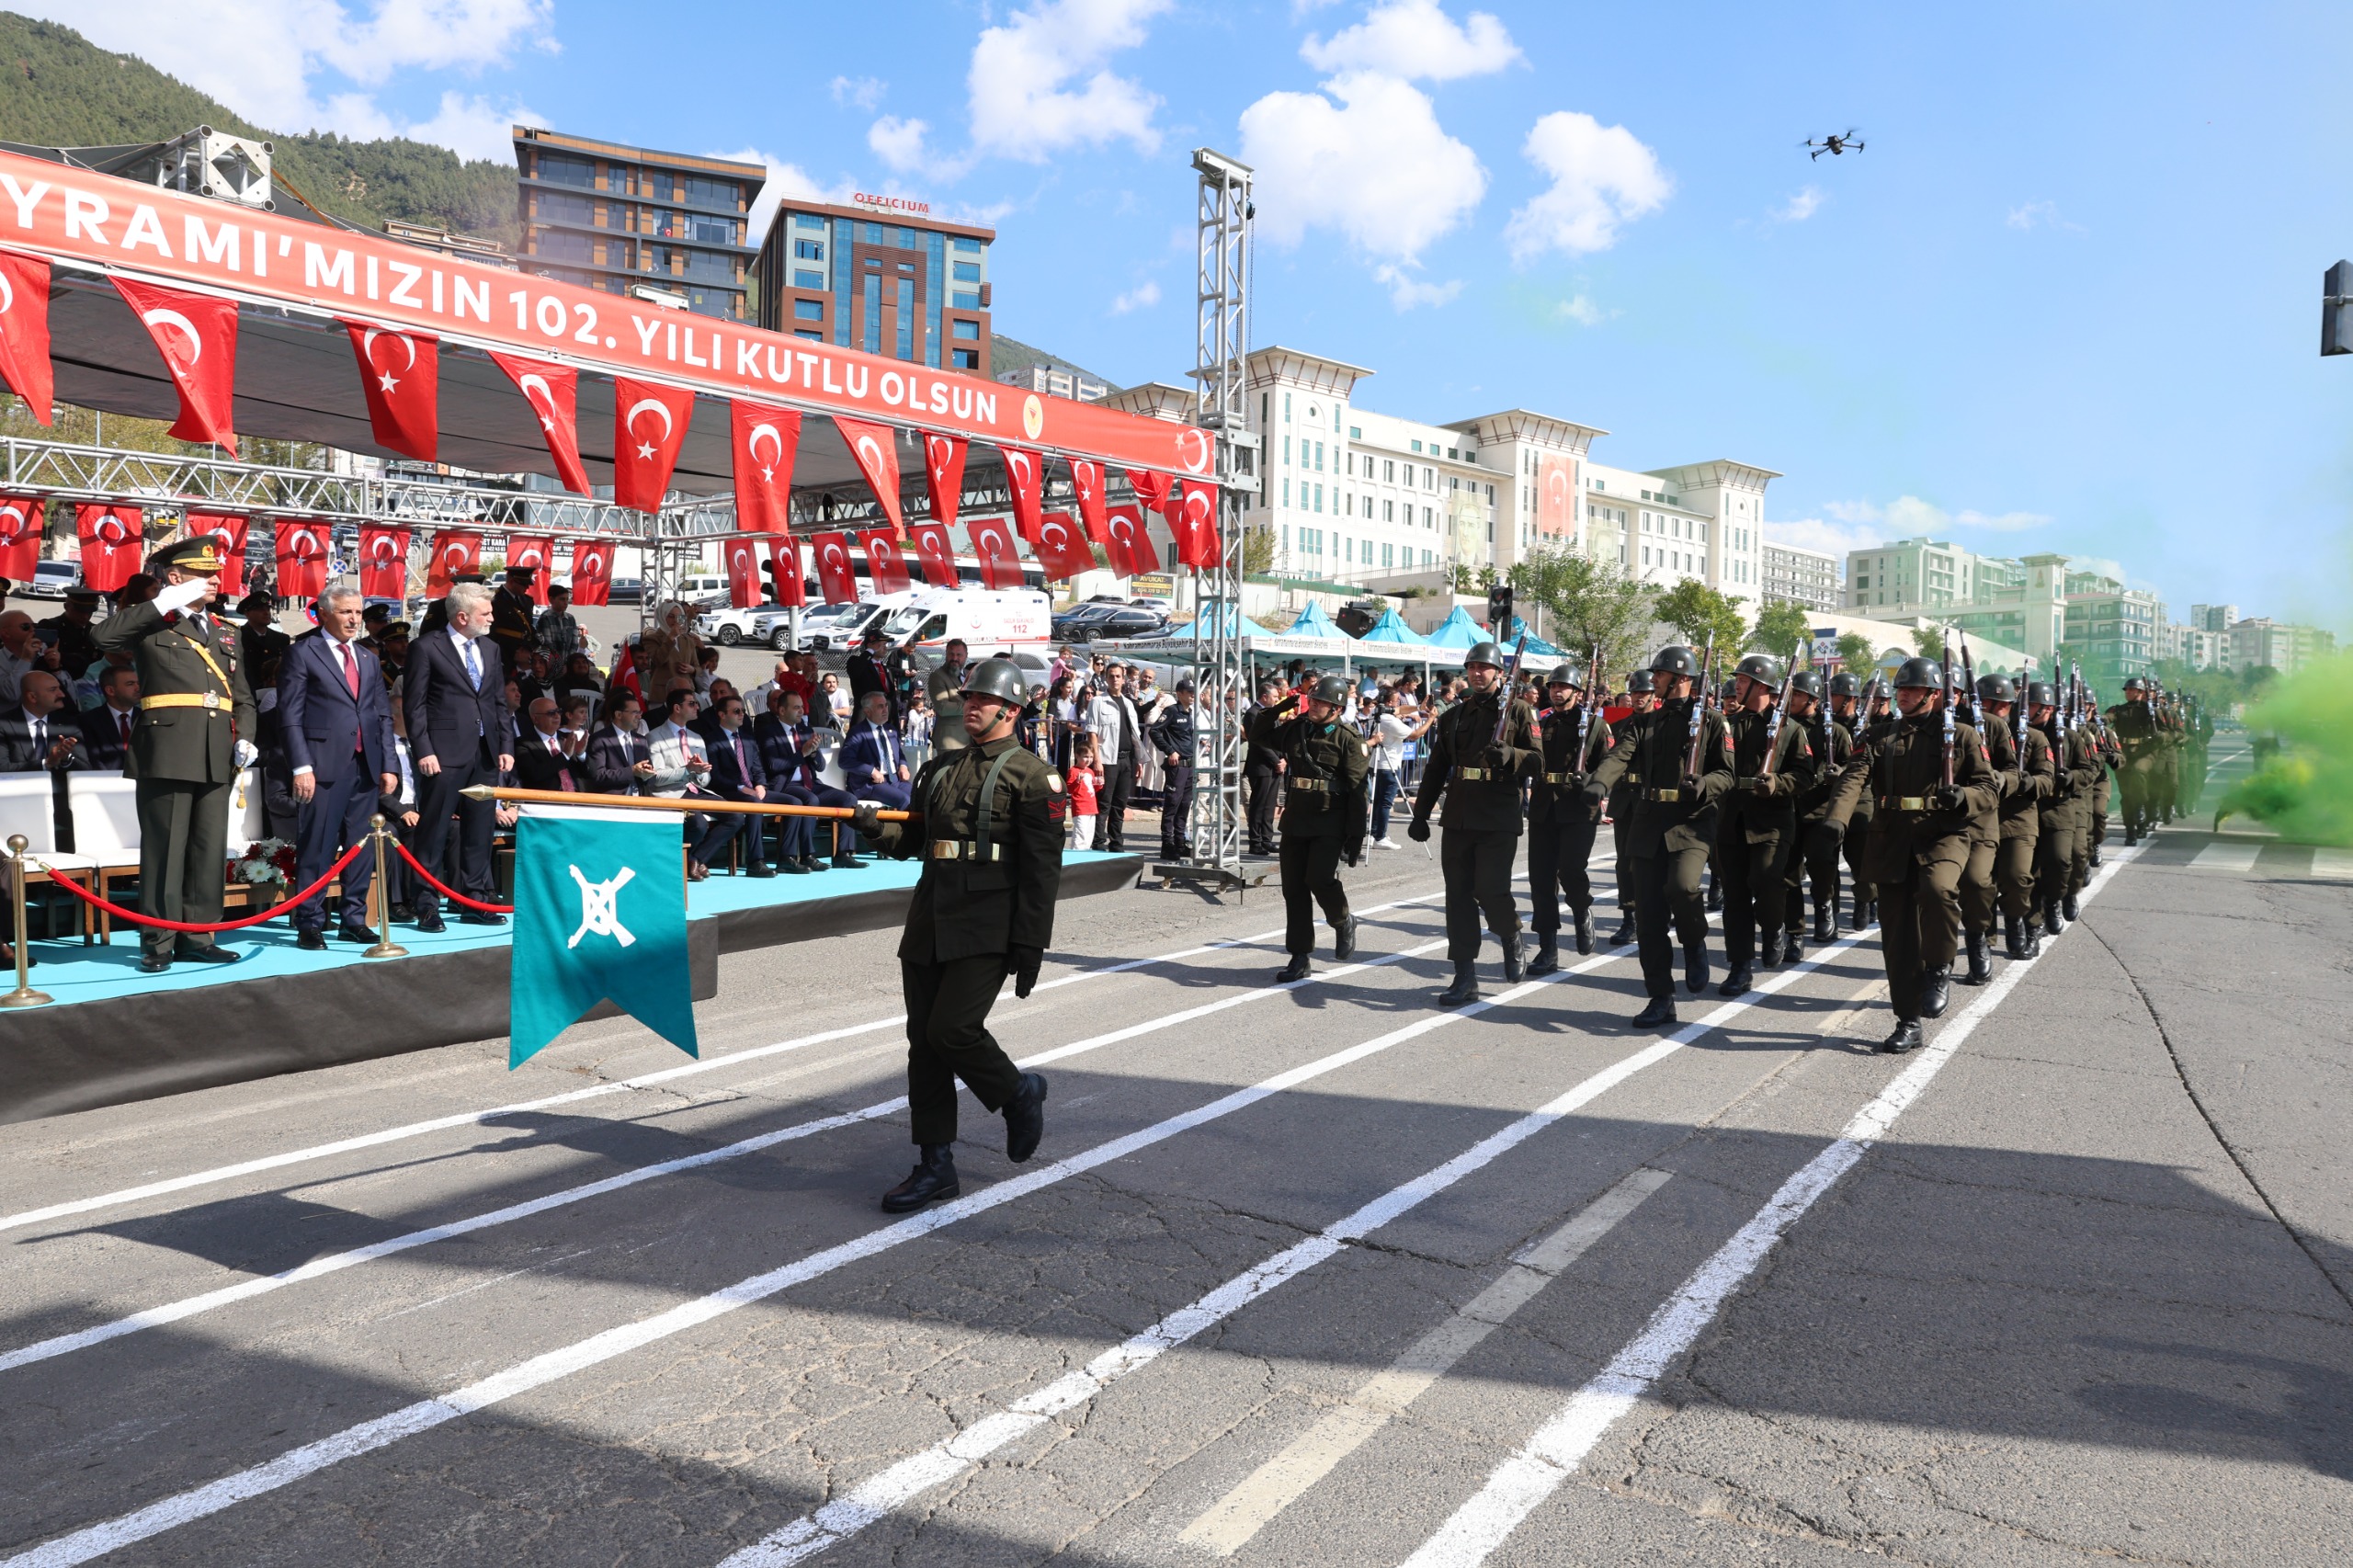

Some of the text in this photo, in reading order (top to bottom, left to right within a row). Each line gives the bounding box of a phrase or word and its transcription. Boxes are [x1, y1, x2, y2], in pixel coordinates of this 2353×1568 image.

[855, 192, 929, 213] OFFICIUM
[509, 290, 617, 349] 102.
[631, 314, 721, 370] YILI
[738, 338, 869, 399] KUTLU
[880, 371, 996, 425] OLSUN
[1140, 575, 1165, 584] AVUKAT
[1012, 624, 1028, 633] 112
